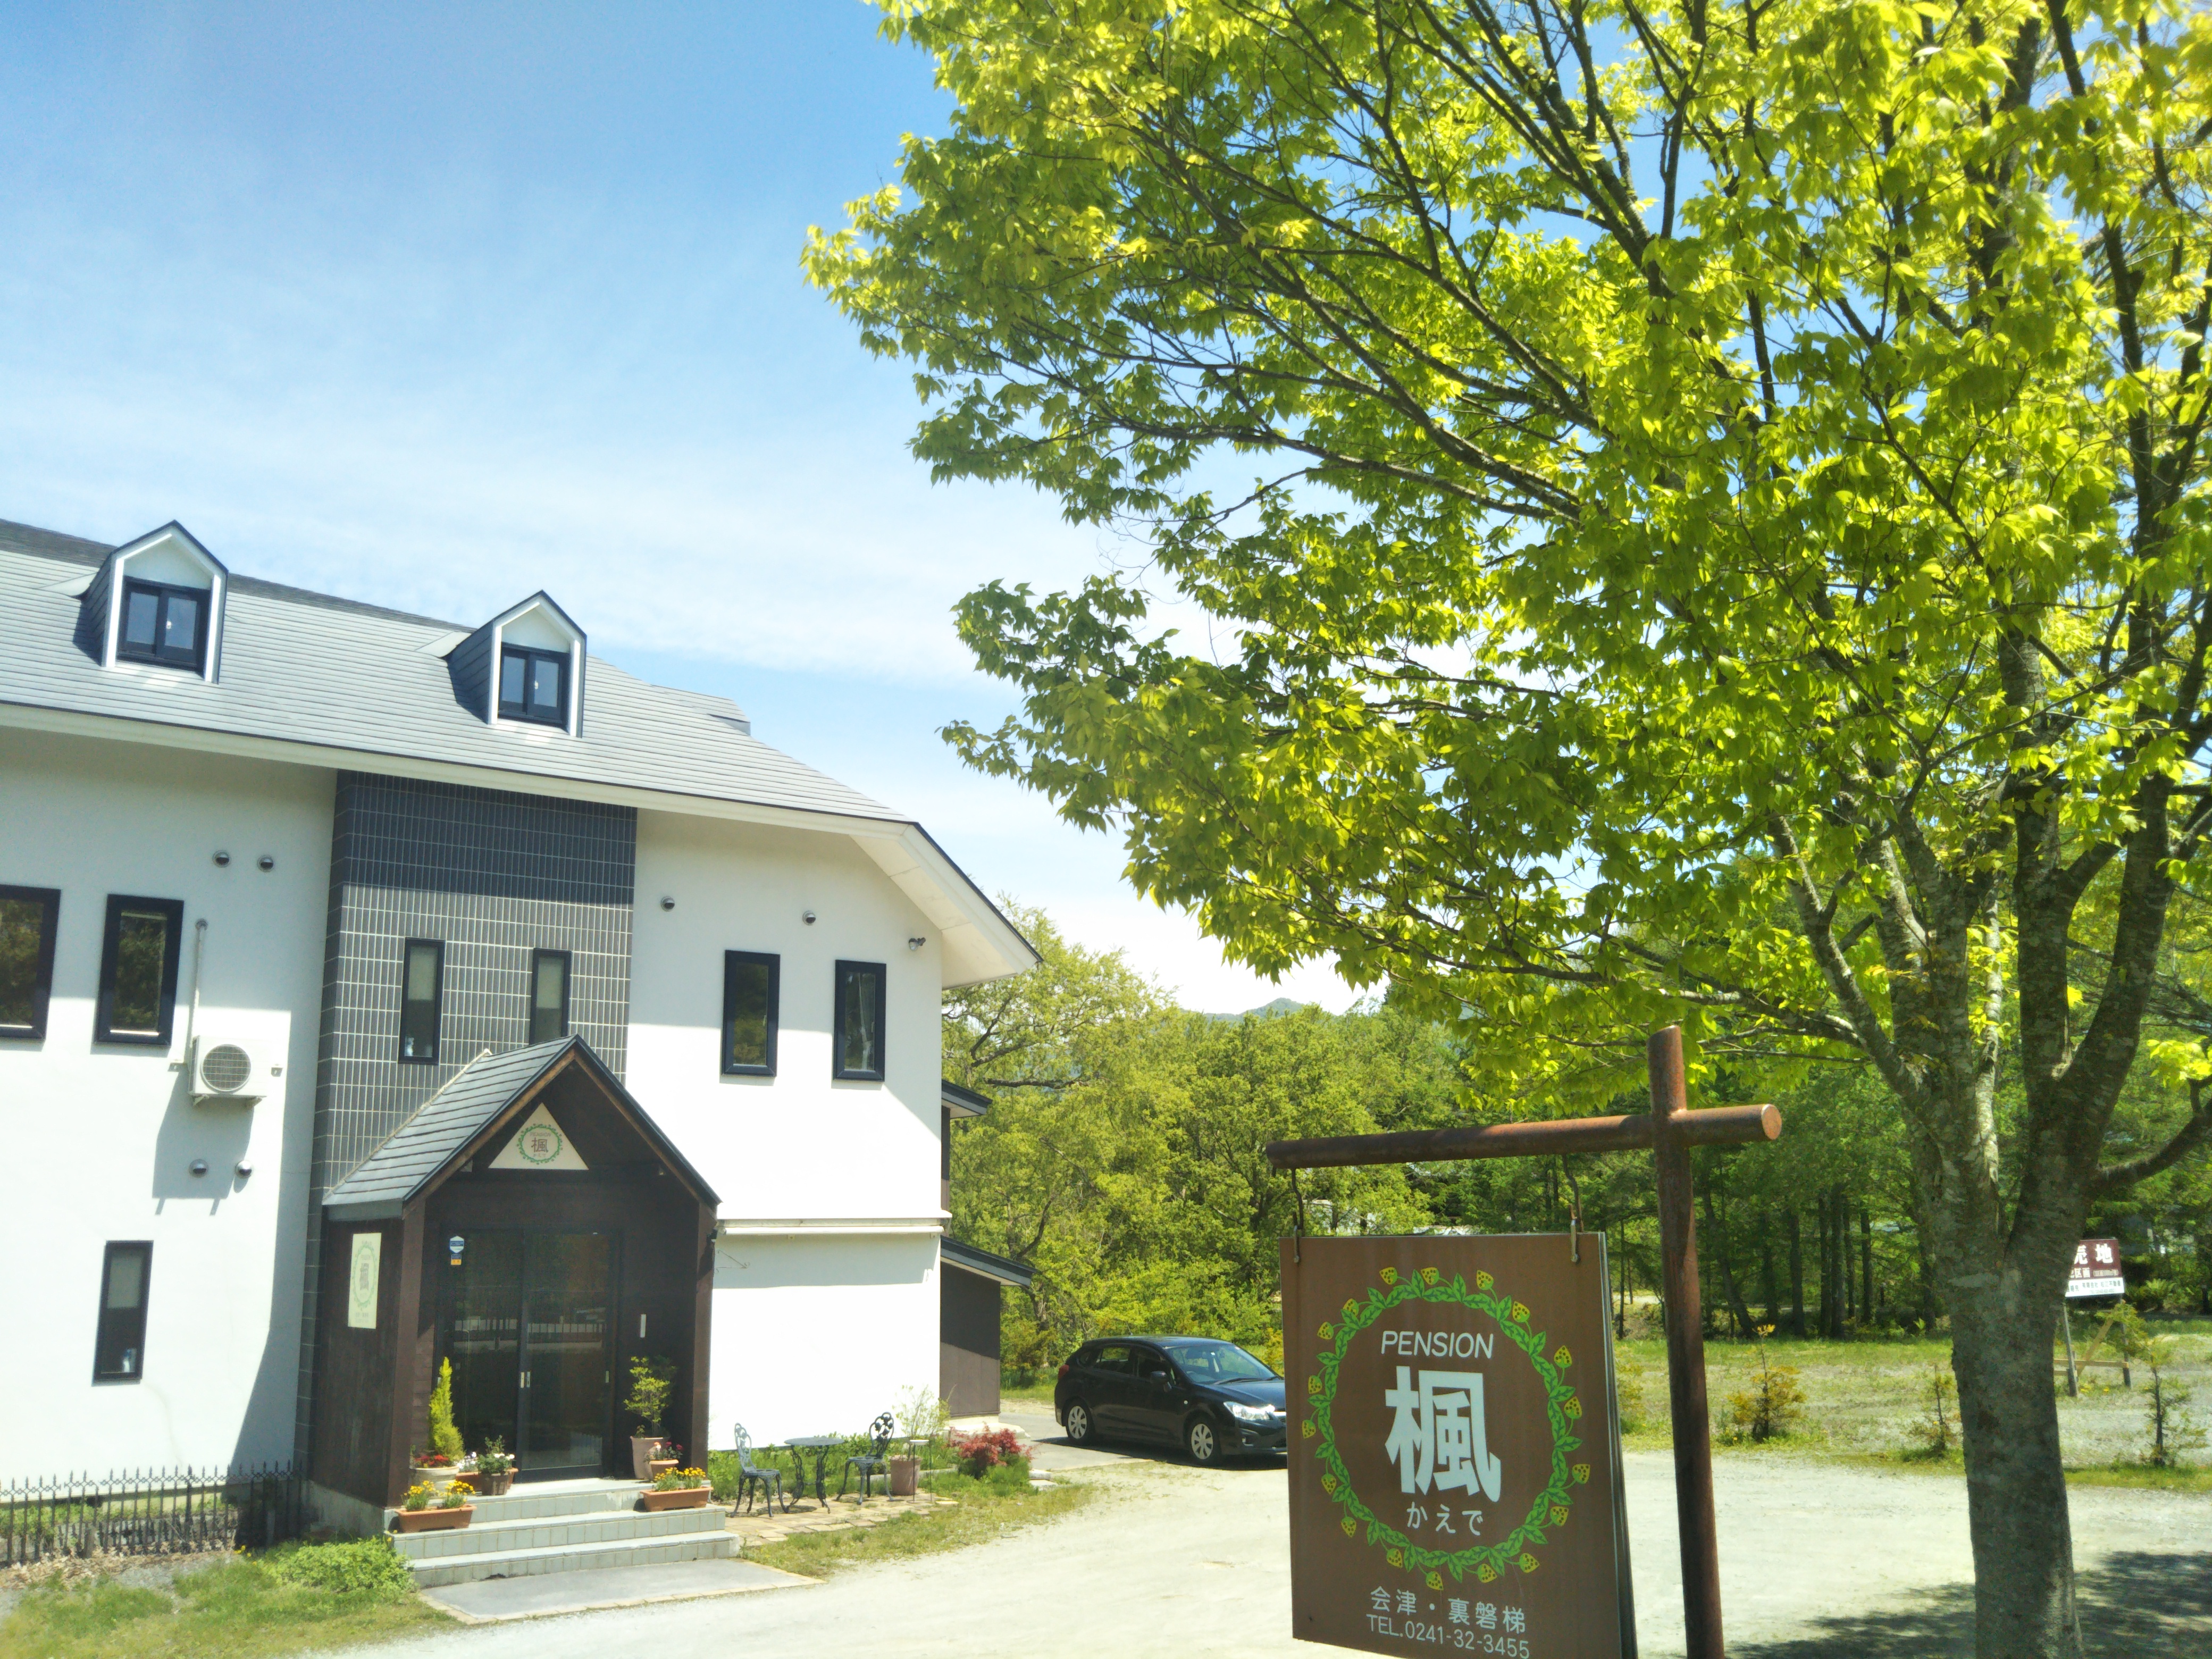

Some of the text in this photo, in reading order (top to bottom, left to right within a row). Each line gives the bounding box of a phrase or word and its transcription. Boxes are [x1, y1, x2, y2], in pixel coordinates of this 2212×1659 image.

[531, 1137, 549, 1153] 楓
[1381, 1330, 1494, 1359] PENSION
[1384, 1365, 1502, 1503] 楓
[1406, 1501, 1484, 1536] かえで
[1370, 1586, 1526, 1634] 会津・裏磐梯
[1365, 1613, 1530, 1659] TEL.0241-32-3455
